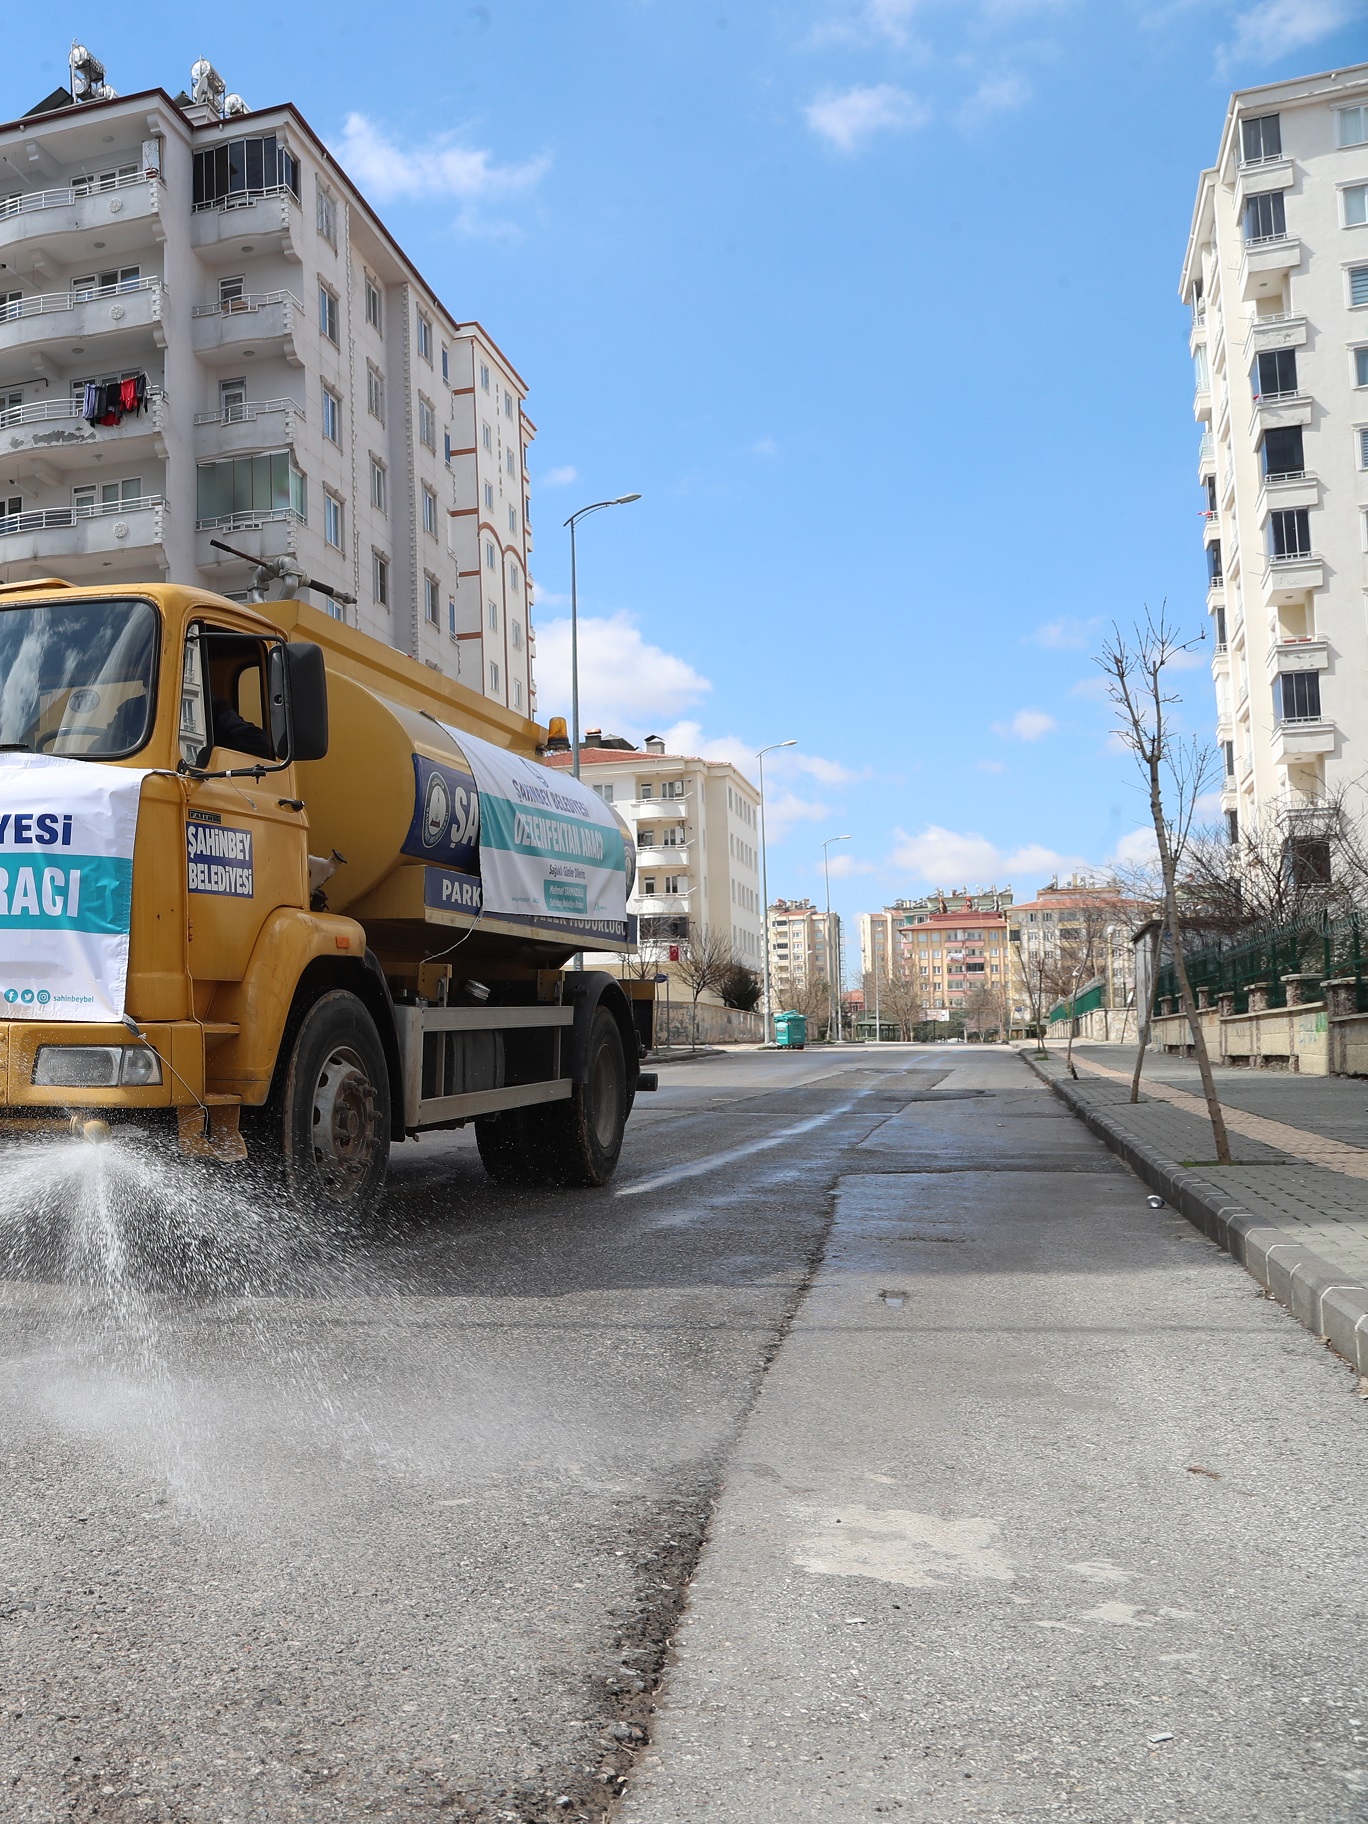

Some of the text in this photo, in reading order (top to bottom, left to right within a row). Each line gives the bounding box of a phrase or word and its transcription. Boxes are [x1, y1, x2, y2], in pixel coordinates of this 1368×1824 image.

[513, 811, 604, 861] DEZENFEKTAN ARACI
[442, 878, 481, 908] PARK
[53, 994, 95, 1004] sahinbeybel
